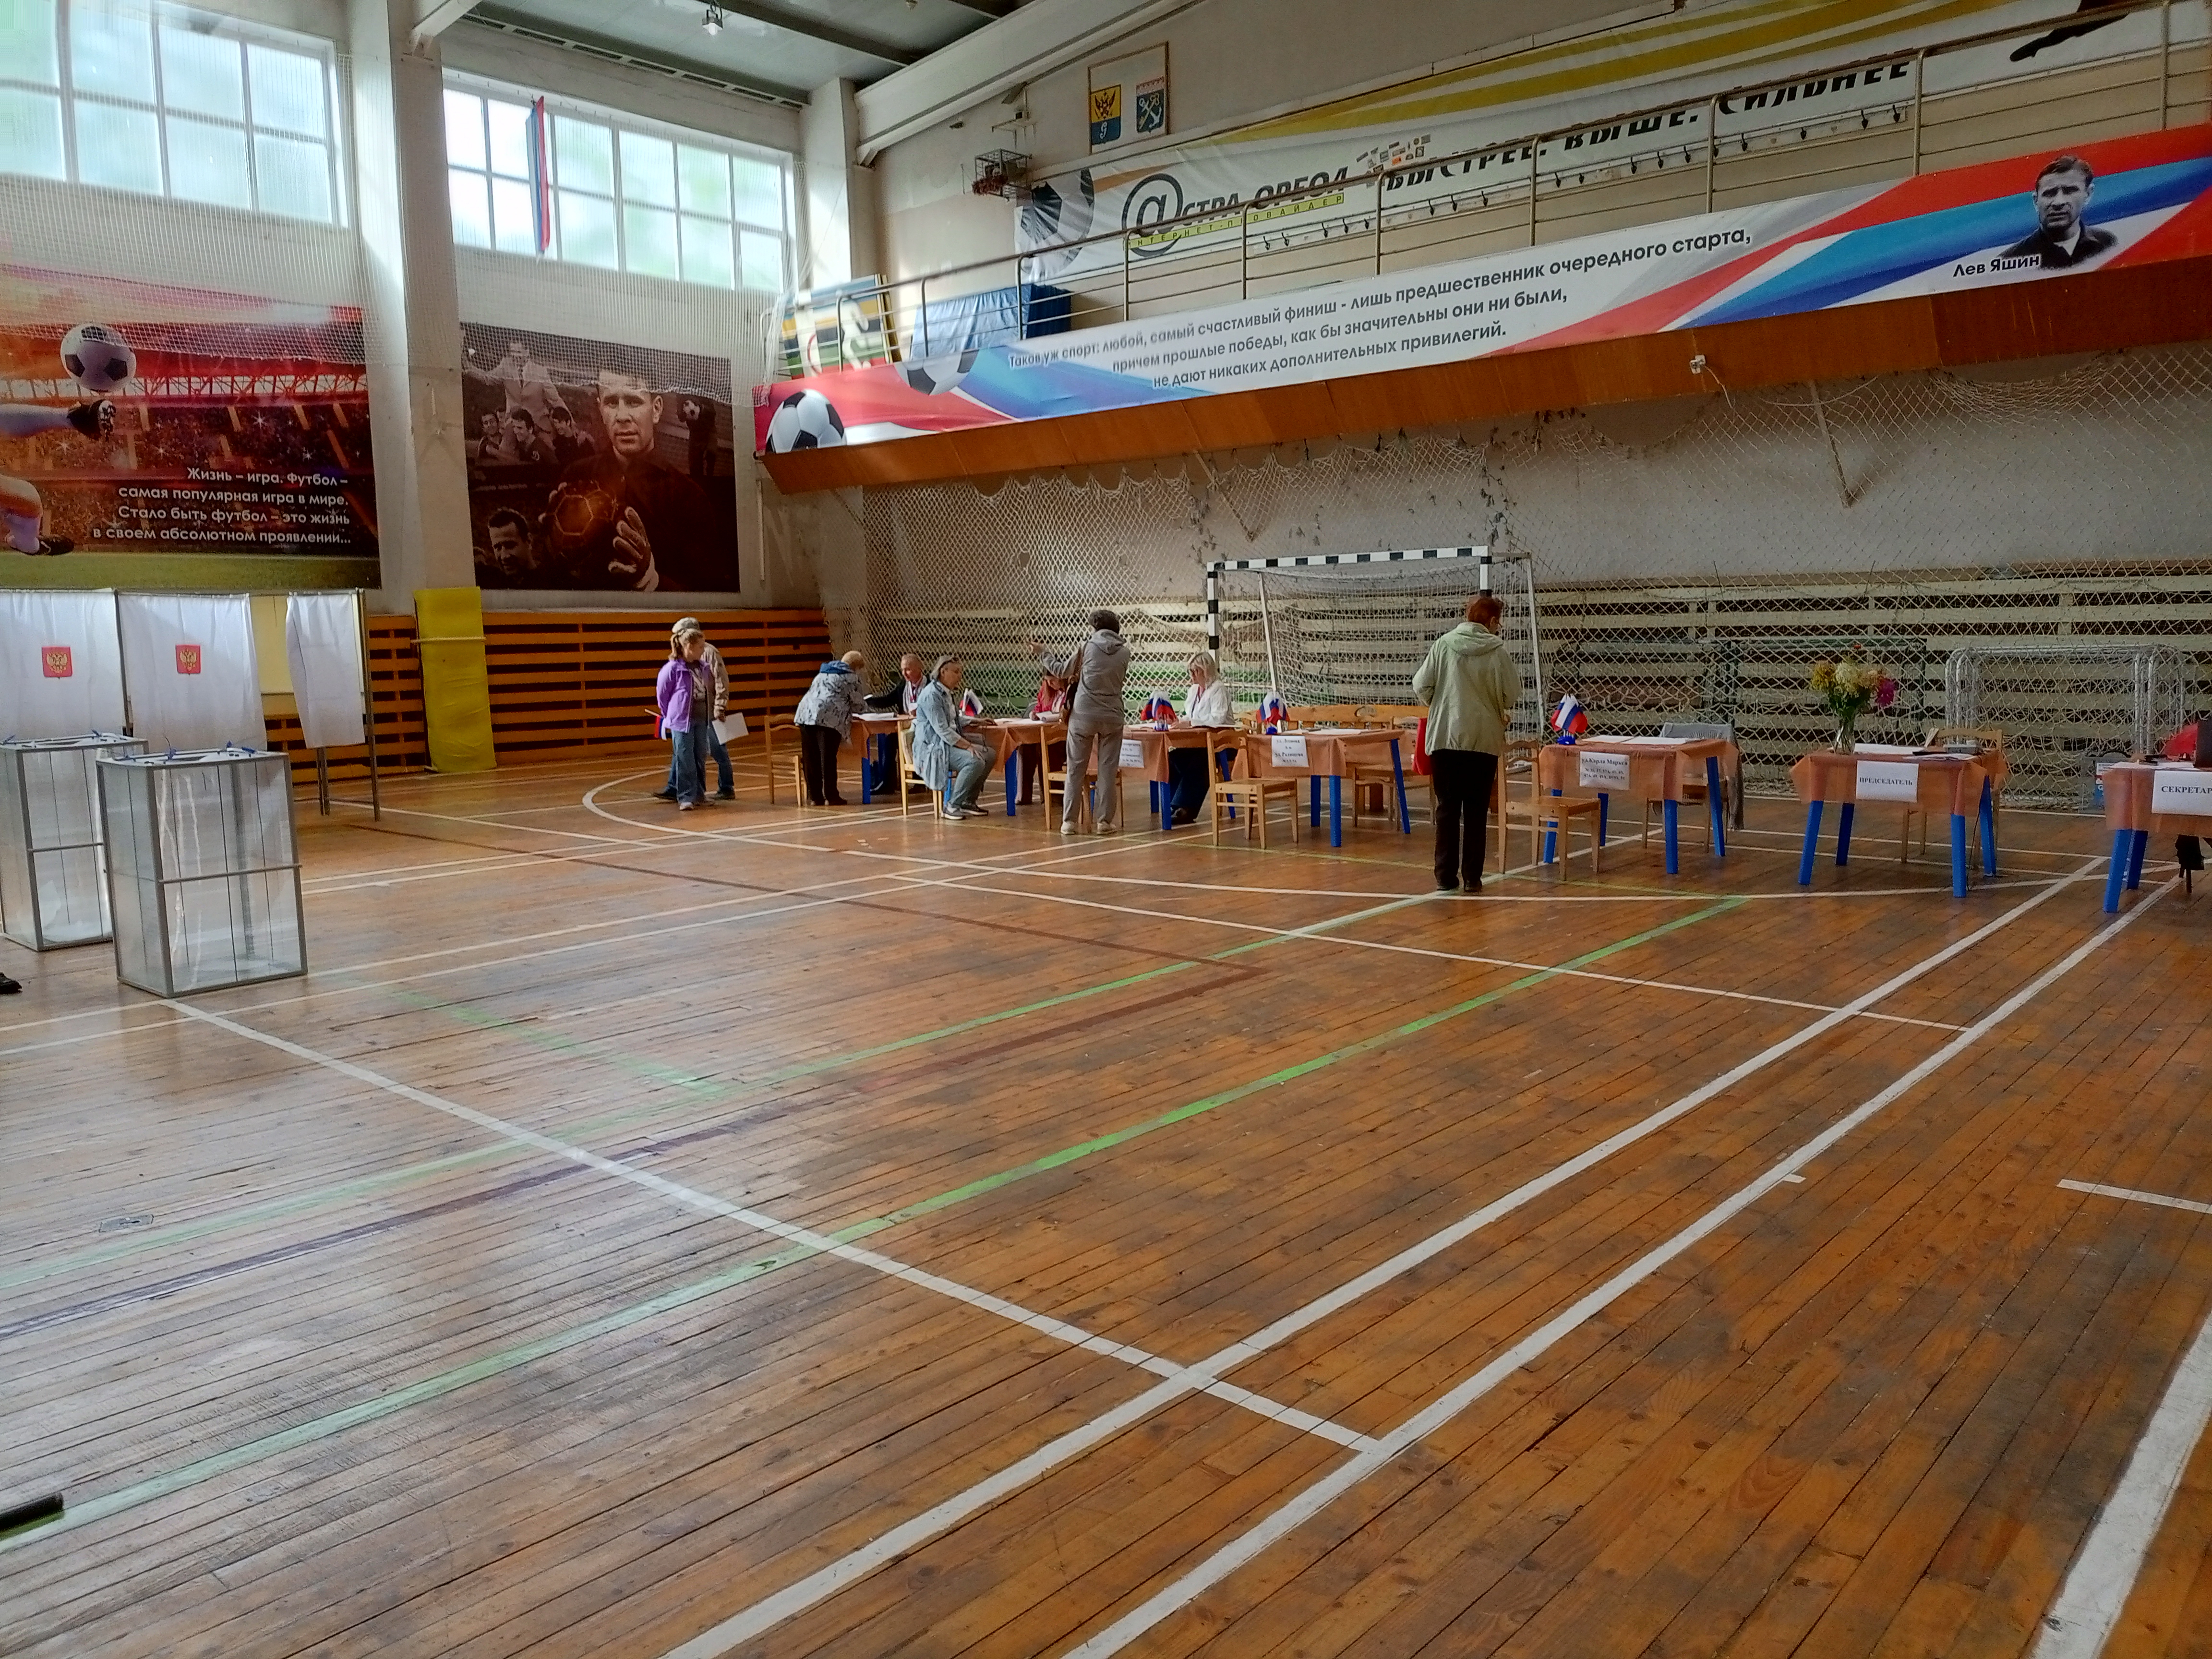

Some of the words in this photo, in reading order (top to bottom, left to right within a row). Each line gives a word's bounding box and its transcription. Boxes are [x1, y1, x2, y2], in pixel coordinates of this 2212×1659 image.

[1953, 264, 1986, 277] Лев
[1990, 256, 2040, 272] Яшин
[1009, 353, 1040, 368] Таков
[1043, 351, 1059, 366] уж
[1062, 343, 1099, 360] спорт:
[1103, 330, 1147, 352] любой,
[1150, 323, 1194, 344] самый
[1198, 308, 1281, 335] счастливый
[1285, 301, 1336, 324] финиш
[1351, 292, 1392, 310] лишь
[1396, 264, 1544, 303] предшественник
[1550, 243, 1667, 275] очередного
[1672, 228, 1751, 253] старта,
[1113, 354, 1159, 373] причем
[1163, 344, 1225, 365] прошлые
[1229, 335, 1287, 353] победы,
[1291, 329, 1316, 344] как
[1320, 324, 1341, 338] бы
[1345, 307, 1448, 335] значительны
[1452, 300, 1484, 318] они
[1489, 297, 1509, 312] ни
[1514, 288, 1567, 308] были,
[1154, 375, 1168, 387] не
[1172, 370, 1206, 386] дают
[1209, 361, 1267, 380] никаких
[1270, 340, 1396, 372] дополнительных
[1401, 320, 1506, 352] привилегий.
[187, 467, 232, 481] Жизнь
[247, 472, 283, 485] игра.
[287, 472, 338, 487] Футбол
[119, 487, 168, 498] самая
[173, 489, 258, 503] популярная
[263, 493, 294, 505] игра
[299, 494, 305, 504] в
[309, 495, 349, 507] мире.
[118, 505, 167, 518] Стало
[171, 507, 207, 520] быть
[211, 508, 268, 523] футбол
[282, 513, 307, 523] это
[310, 514, 350, 525] жизнь
[93, 529, 101, 538] в
[106, 529, 156, 539] своем
[160, 527, 256, 541] абсолютном
[260, 531, 351, 544] проявлении...
[1860, 777, 1912, 785] ПРЕДСЕДАТЕЛЬ
